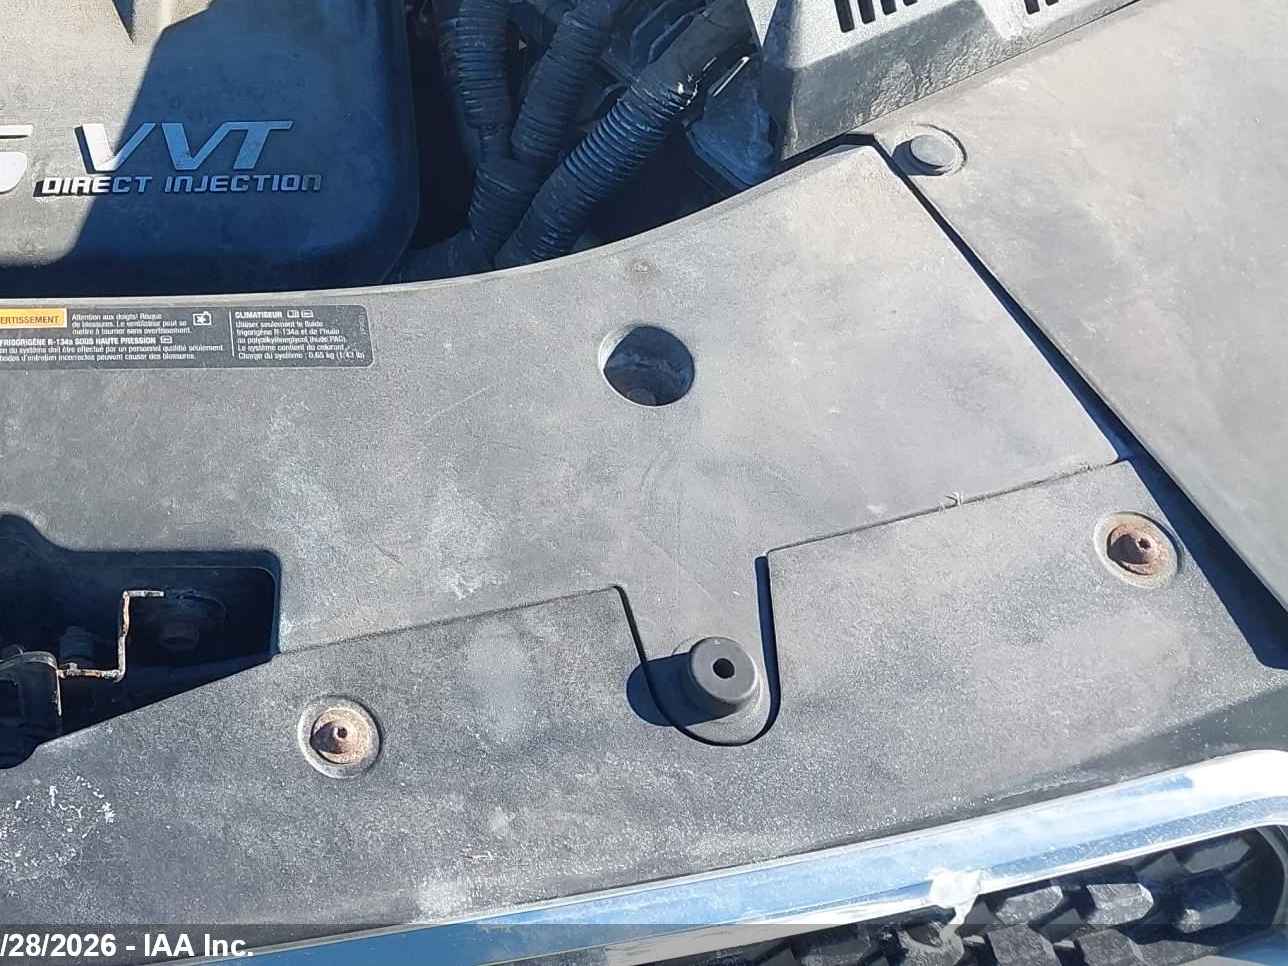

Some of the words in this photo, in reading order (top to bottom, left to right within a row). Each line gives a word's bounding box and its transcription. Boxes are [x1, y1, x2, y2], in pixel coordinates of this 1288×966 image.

[75, 120, 293, 174] VVT
[35, 175, 152, 197] DIRECT
[164, 175, 323, 194] INJECTION
[72, 313, 101, 321] Attention
[139, 313, 162, 321] Risque
[235, 311, 283, 319] CLIMATISEUR
[162, 320, 178, 328] peut
[260, 320, 296, 328] seulement
[273, 328, 300, 336] R-134a
[47, 337, 74, 346] R-134a
[74, 337, 94, 345] SOUS
[95, 337, 119, 345] HAUTE
[120, 336, 156, 345] PRESSION
[9, 346, 18, 354] du
[18, 346, 47, 354] système
[48, 345, 61, 354] doit
[62, 345, 77, 353] être
[77, 345, 104, 353] effectué
[105, 346, 117, 354] par
[128, 345, 161, 353] personnel
[237, 344, 247, 352] Le
[247, 345, 277, 353] système
[277, 344, 305, 352] contient
[58, 353, 95, 361] incorrectes
[96, 353, 124, 362] peuvent
[238, 352, 264, 361] Charge
[264, 352, 274, 360] du
[274, 352, 304, 361] système
[326, 351, 336, 360] kg
